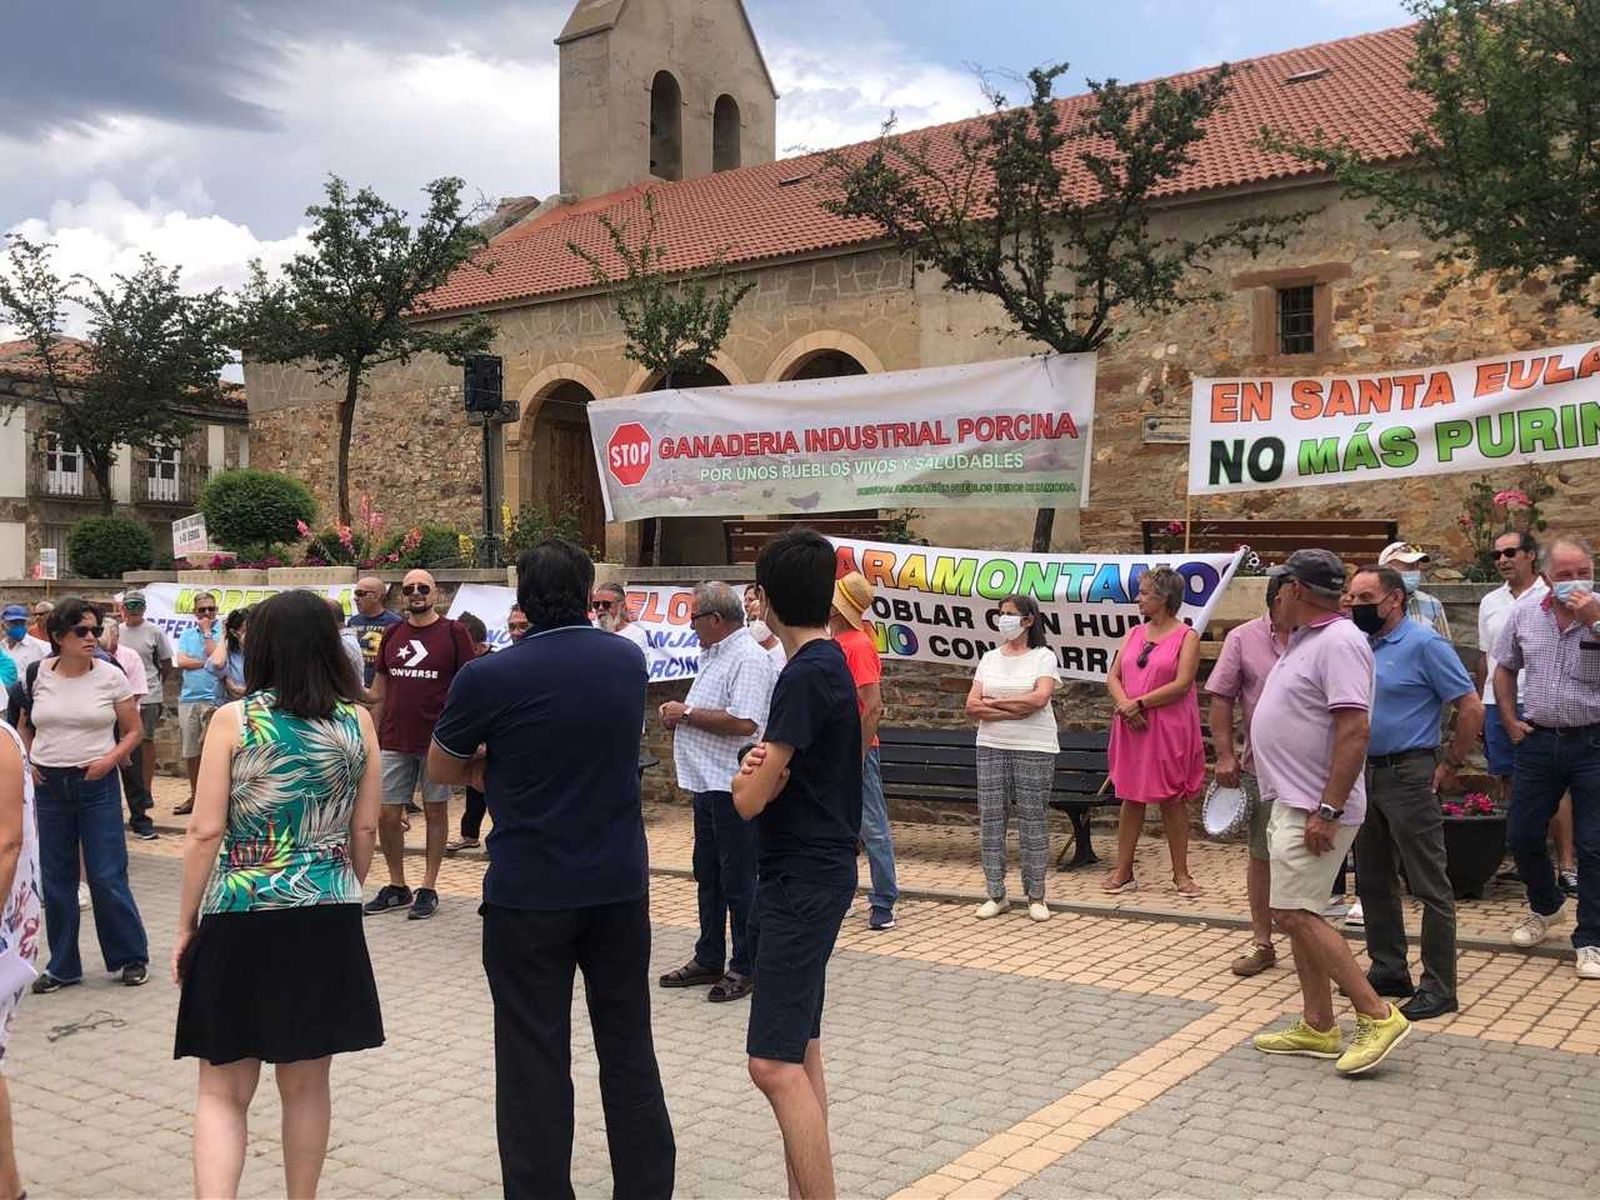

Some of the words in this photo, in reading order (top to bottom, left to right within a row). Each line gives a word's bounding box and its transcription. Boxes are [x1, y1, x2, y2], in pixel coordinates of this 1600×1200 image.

[1210, 382, 1273, 423] EN
[1291, 371, 1455, 420] SANTA
[611, 441, 650, 468] STOP
[658, 430, 801, 460] GANADERIA
[804, 420, 951, 453] INDUSTRIAL
[957, 412, 1079, 443] PORCINA
[1209, 436, 1285, 485] NO
[1297, 422, 1419, 476] MÁS
[700, 467, 732, 482] POR
[736, 465, 778, 481] UNOS
[782, 463, 850, 480] PUEBLOS
[855, 459, 897, 475] VIVOS
[902, 459, 912, 472] Y
[915, 453, 1024, 471] SALUDABLES
[835, 545, 1232, 607] ARAMONTAO
[626, 591, 693, 625] ELO
[872, 596, 975, 630] OBLAR
[985, 608, 1062, 635] CN
[649, 656, 699, 678] RCIN
